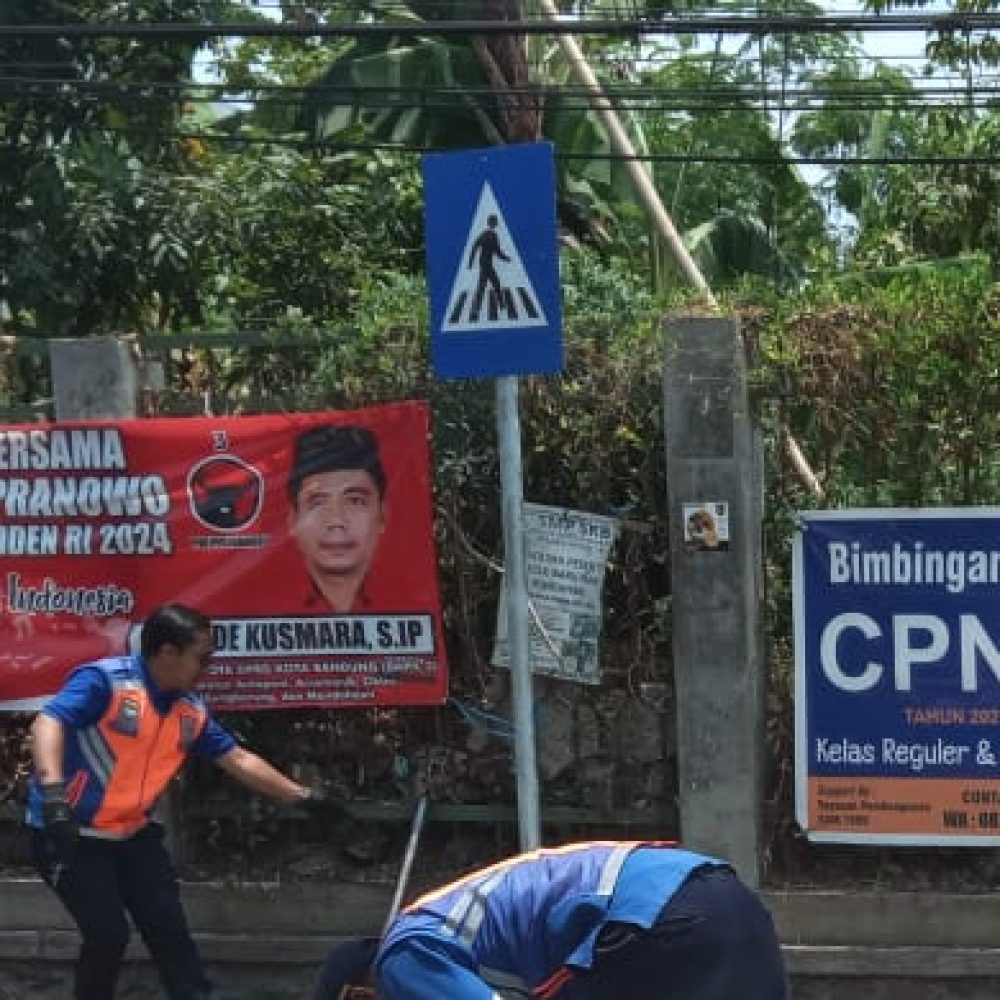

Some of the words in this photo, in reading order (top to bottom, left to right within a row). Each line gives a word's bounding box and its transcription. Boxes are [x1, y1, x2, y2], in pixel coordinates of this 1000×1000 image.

[64, 524, 93, 555] RI
[99, 522, 172, 555] 2024
[8, 571, 134, 615] Indonesia
[245, 620, 373, 652] KUSMARA,
[376, 618, 424, 648] S.IP
[816, 738, 875, 764] Kelas
[881, 738, 970, 770] Reguler
[976, 738, 996, 765] &
